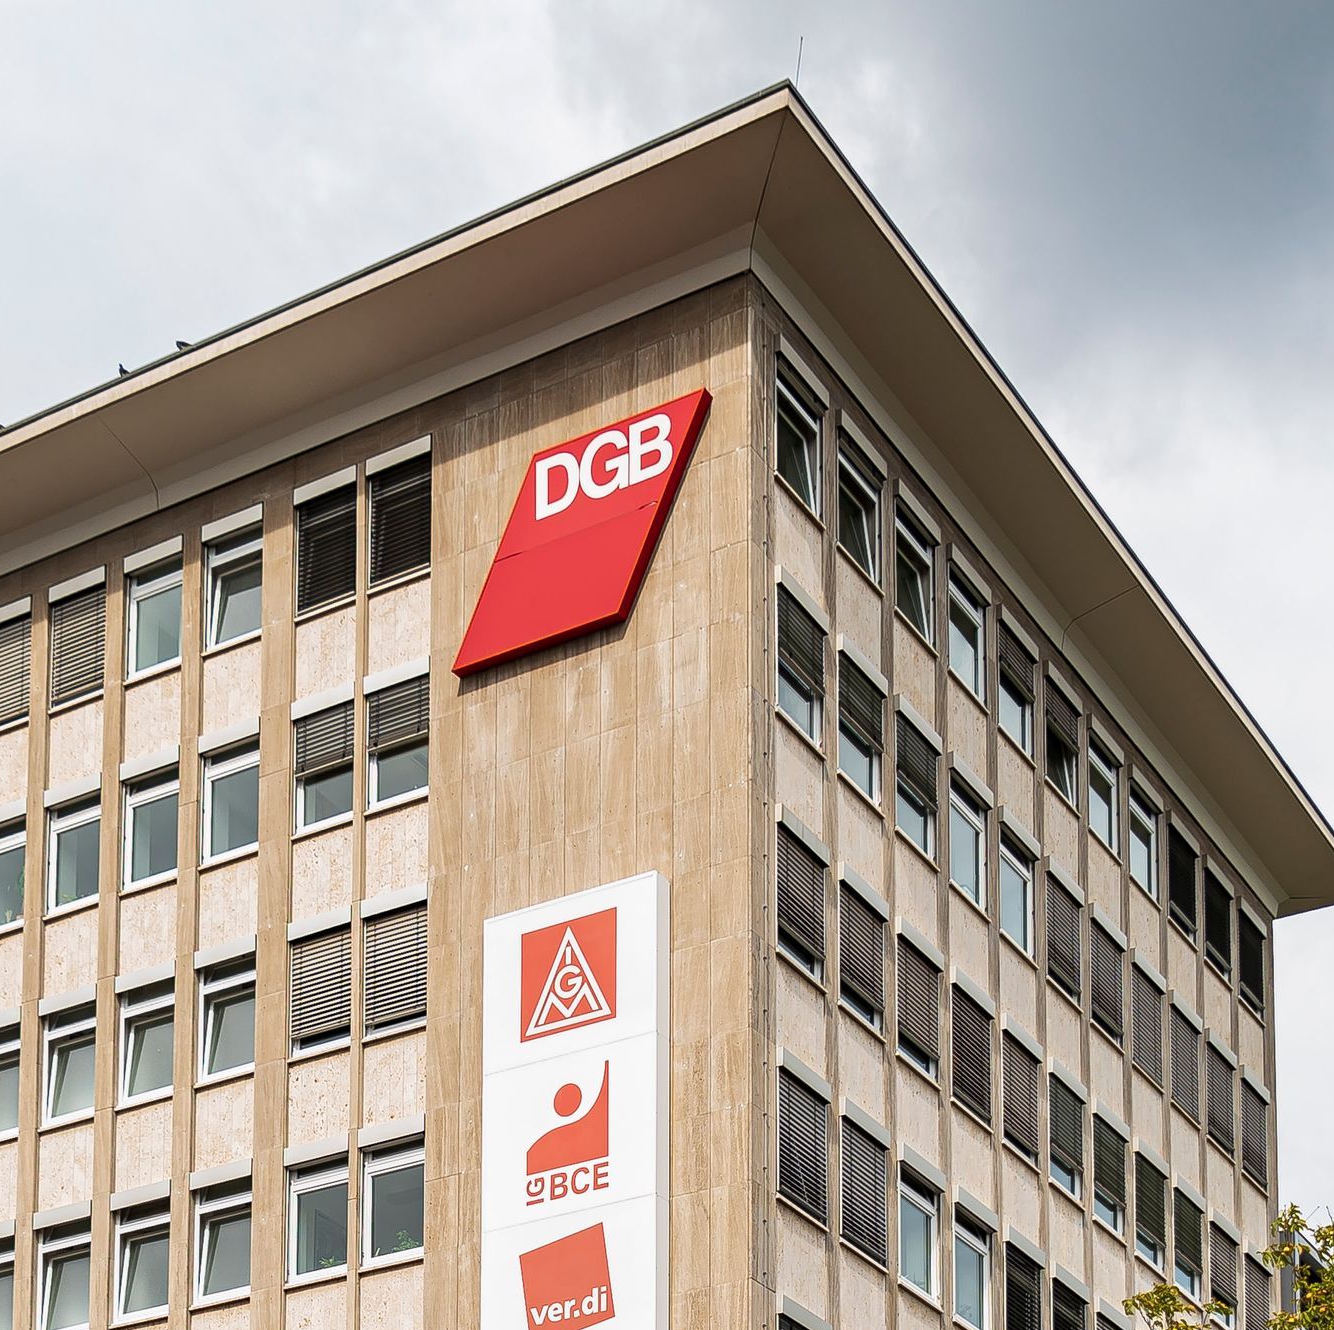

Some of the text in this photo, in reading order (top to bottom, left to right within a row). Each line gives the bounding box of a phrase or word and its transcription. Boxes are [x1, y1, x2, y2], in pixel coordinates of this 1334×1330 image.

[535, 413, 673, 521] DGB
[550, 1161, 609, 1200] BCE
[530, 1285, 608, 1327] ver.di
